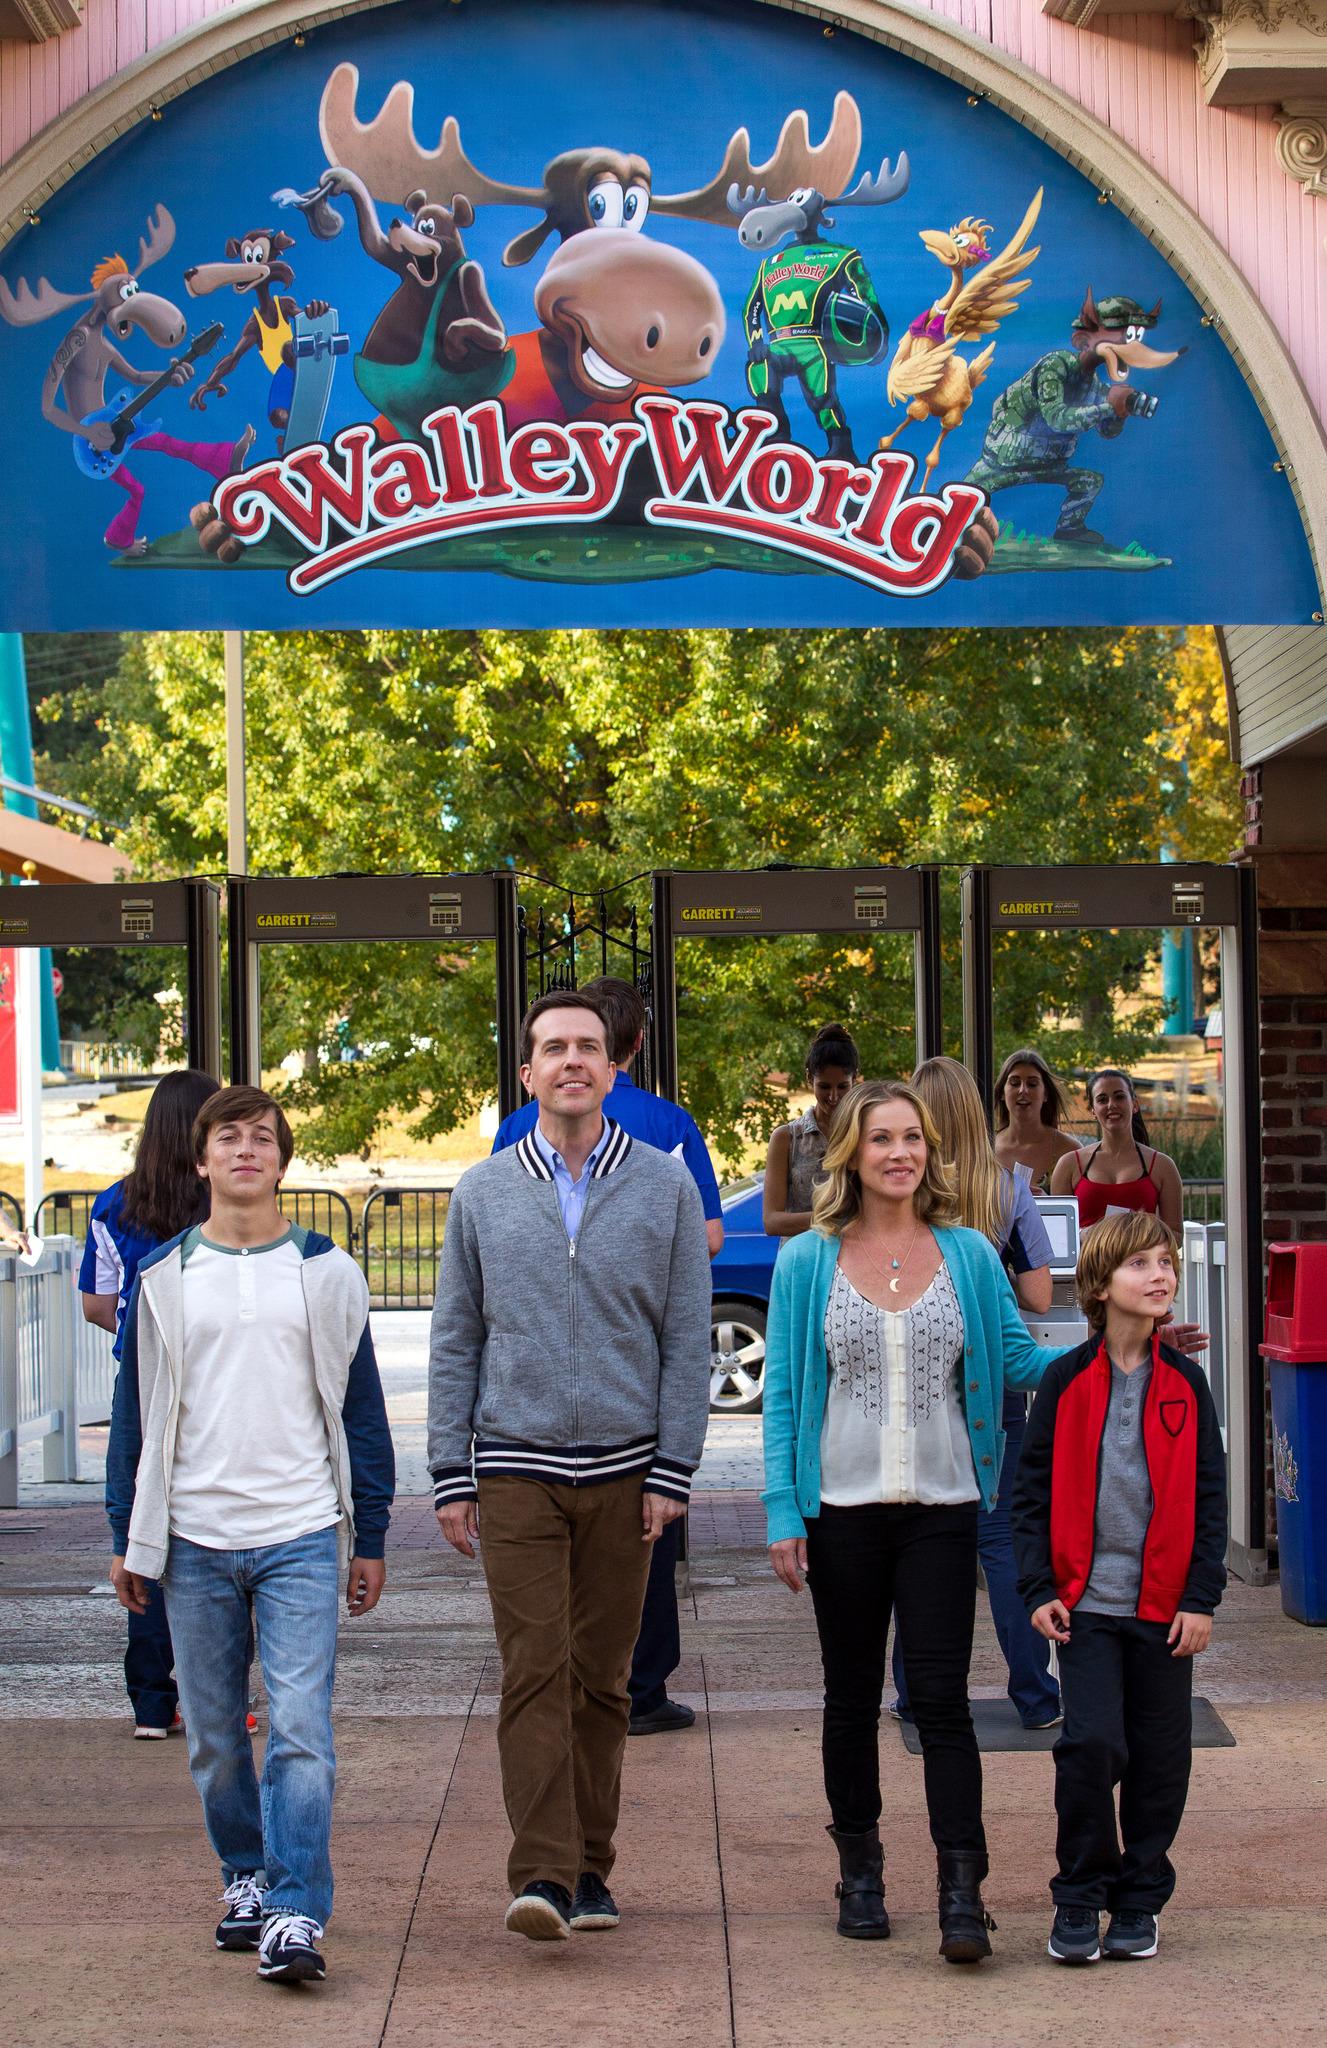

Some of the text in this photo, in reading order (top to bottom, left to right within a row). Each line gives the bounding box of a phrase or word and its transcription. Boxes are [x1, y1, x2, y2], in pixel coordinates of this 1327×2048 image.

[764, 262, 829, 291] Walley World
[218, 398, 982, 594] Walley World
[682, 908, 736, 920] GARRETT
[1000, 902, 1053, 914] GARRETT
[257, 914, 311, 927] GARRETT
